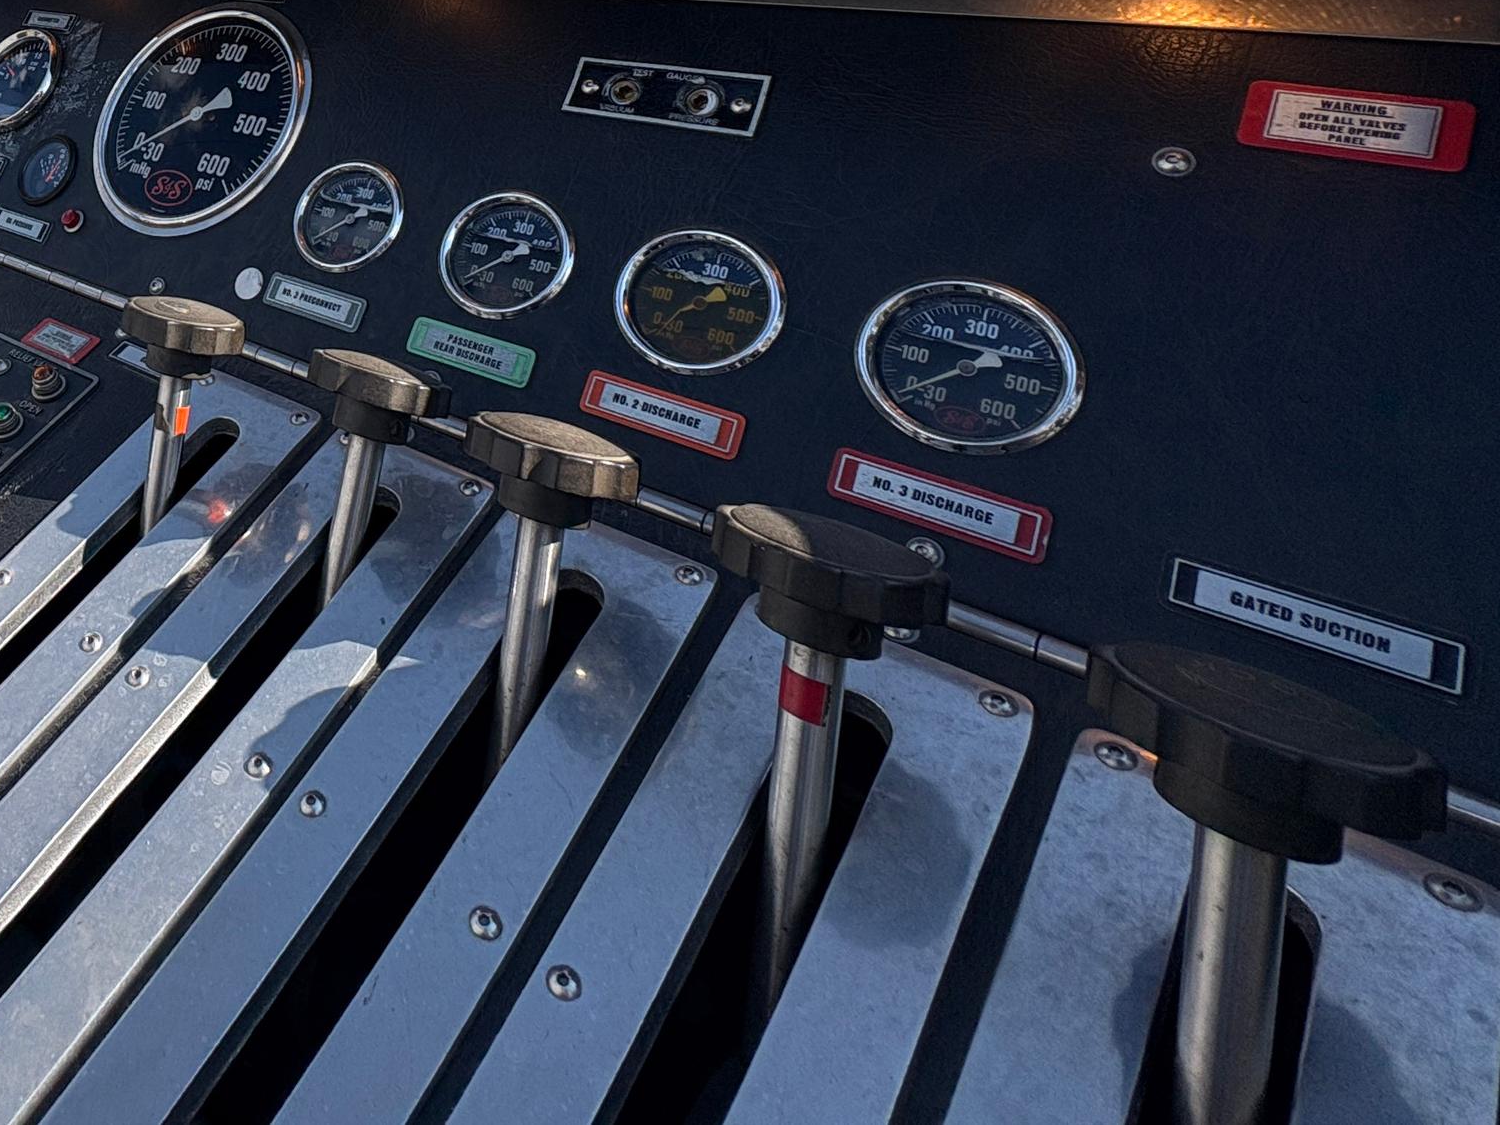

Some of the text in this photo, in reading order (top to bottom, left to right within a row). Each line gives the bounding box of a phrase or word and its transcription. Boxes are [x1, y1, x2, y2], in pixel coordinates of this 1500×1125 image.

[216, 43, 248, 63] 300
[171, 57, 201, 75] 200
[238, 71, 270, 92] 400
[666, 72, 704, 83] GAUG
[142, 90, 167, 110] 100
[1320, 100, 1388, 116] WARNING
[233, 113, 267, 136] 500
[1299, 112, 1407, 132] OPEN ALL VALVES
[1299, 121, 1402, 140] BEFORE OPENING
[1327, 134, 1366, 146] PANEL
[197, 153, 230, 177] 600
[195, 177, 214, 192] psi
[355, 187, 375, 200] 300
[320, 206, 335, 218] 100
[368, 220, 385, 232] 500
[512, 221, 535, 235] 300
[470, 242, 489, 256] 100
[528, 259, 551, 274] 500
[702, 263, 729, 280] 300
[512, 278, 534, 293] 600
[652, 286, 673, 301] 100
[300, 291, 342, 313] PRECONNECT
[727, 307, 755, 324] 500
[707, 328, 735, 346] 600
[922, 324, 955, 341] 200
[964, 318, 1000, 340] 300
[447, 334, 495, 356] PASSENGER
[901, 344, 930, 364] 100
[8, 348, 35, 365] RELIEF
[433, 340, 503, 370] REAR DISCHARGE
[1004, 374, 1041, 395] 500
[19, 400, 41, 415] OPEN
[612, 392, 702, 429] NO. 2 DISCHARGE
[980, 398, 1017, 420] 600
[872, 476, 994, 525] NO. 3 DISCHARGE
[1229, 590, 1391, 654] GATED SUCTION
